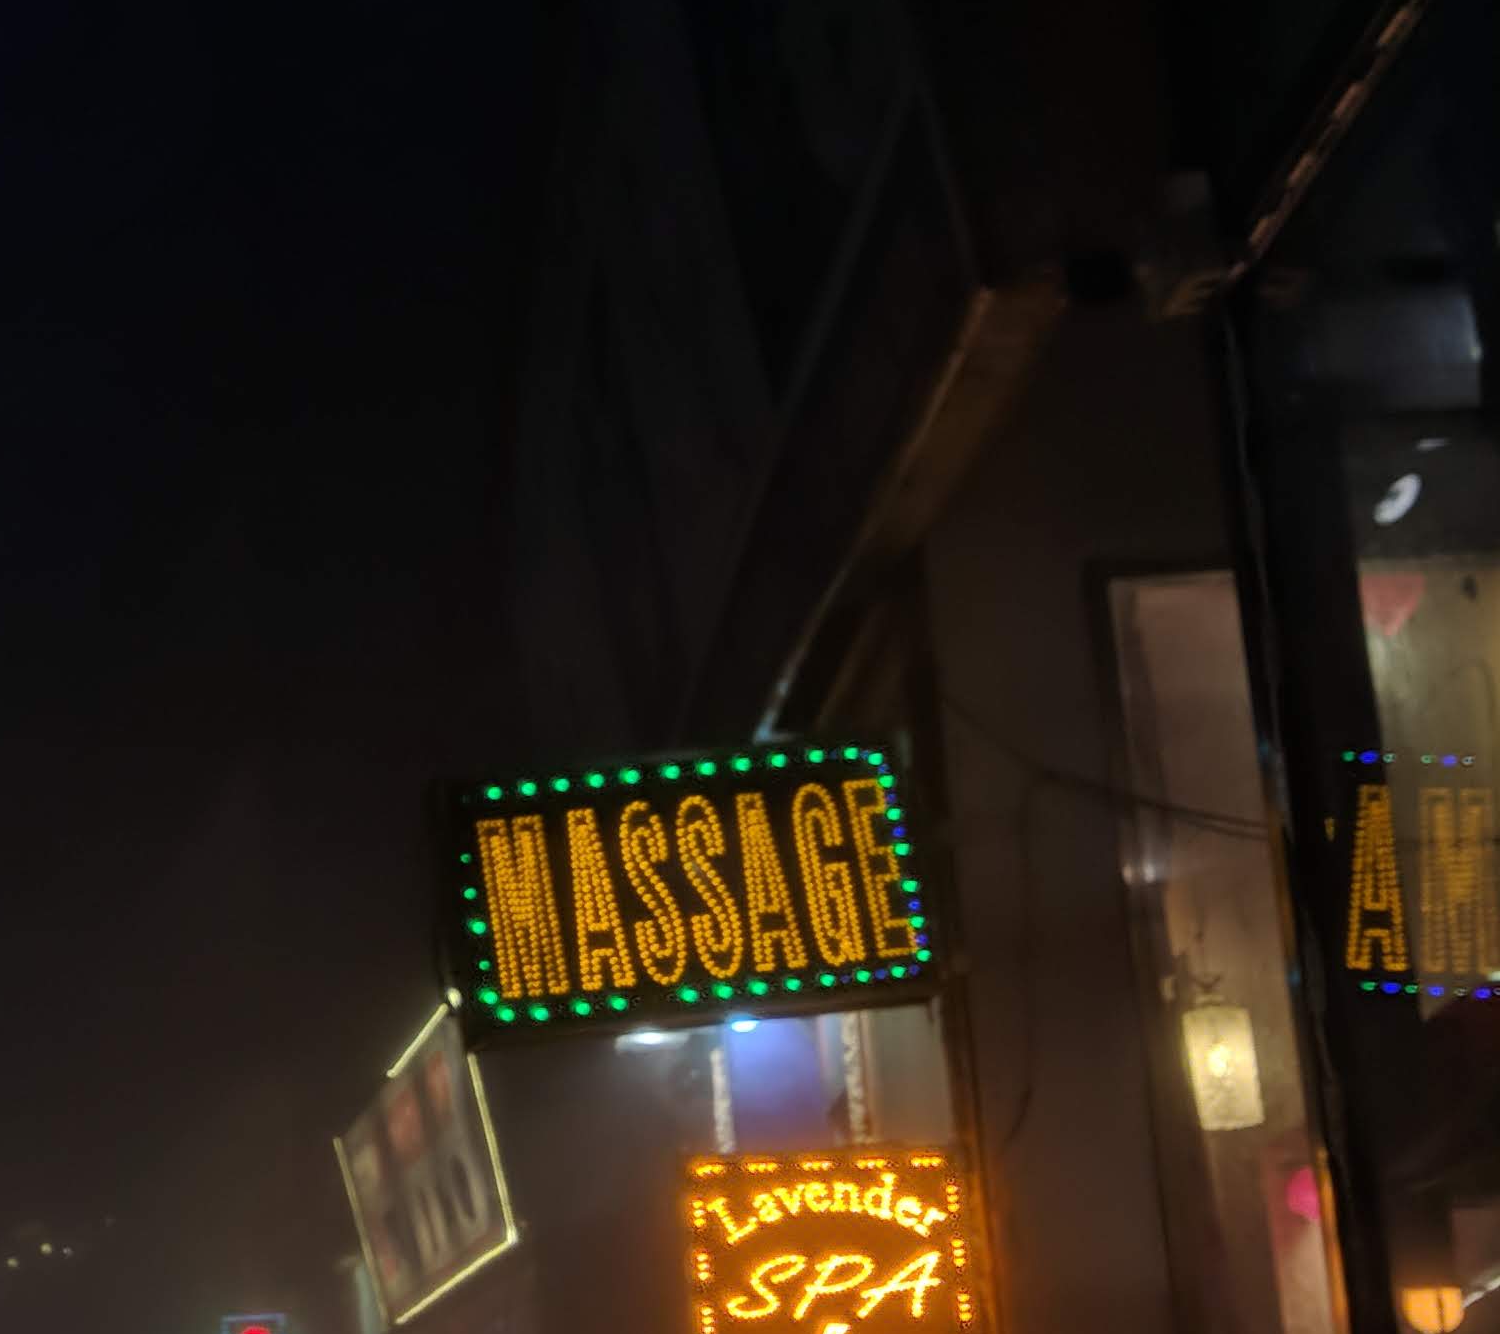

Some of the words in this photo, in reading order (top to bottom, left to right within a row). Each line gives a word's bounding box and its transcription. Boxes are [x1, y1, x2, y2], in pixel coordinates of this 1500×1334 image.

[475, 777, 917, 1000] MASSAGE
[708, 1172, 947, 1244] Lavender
[726, 1250, 942, 1320] SPA
